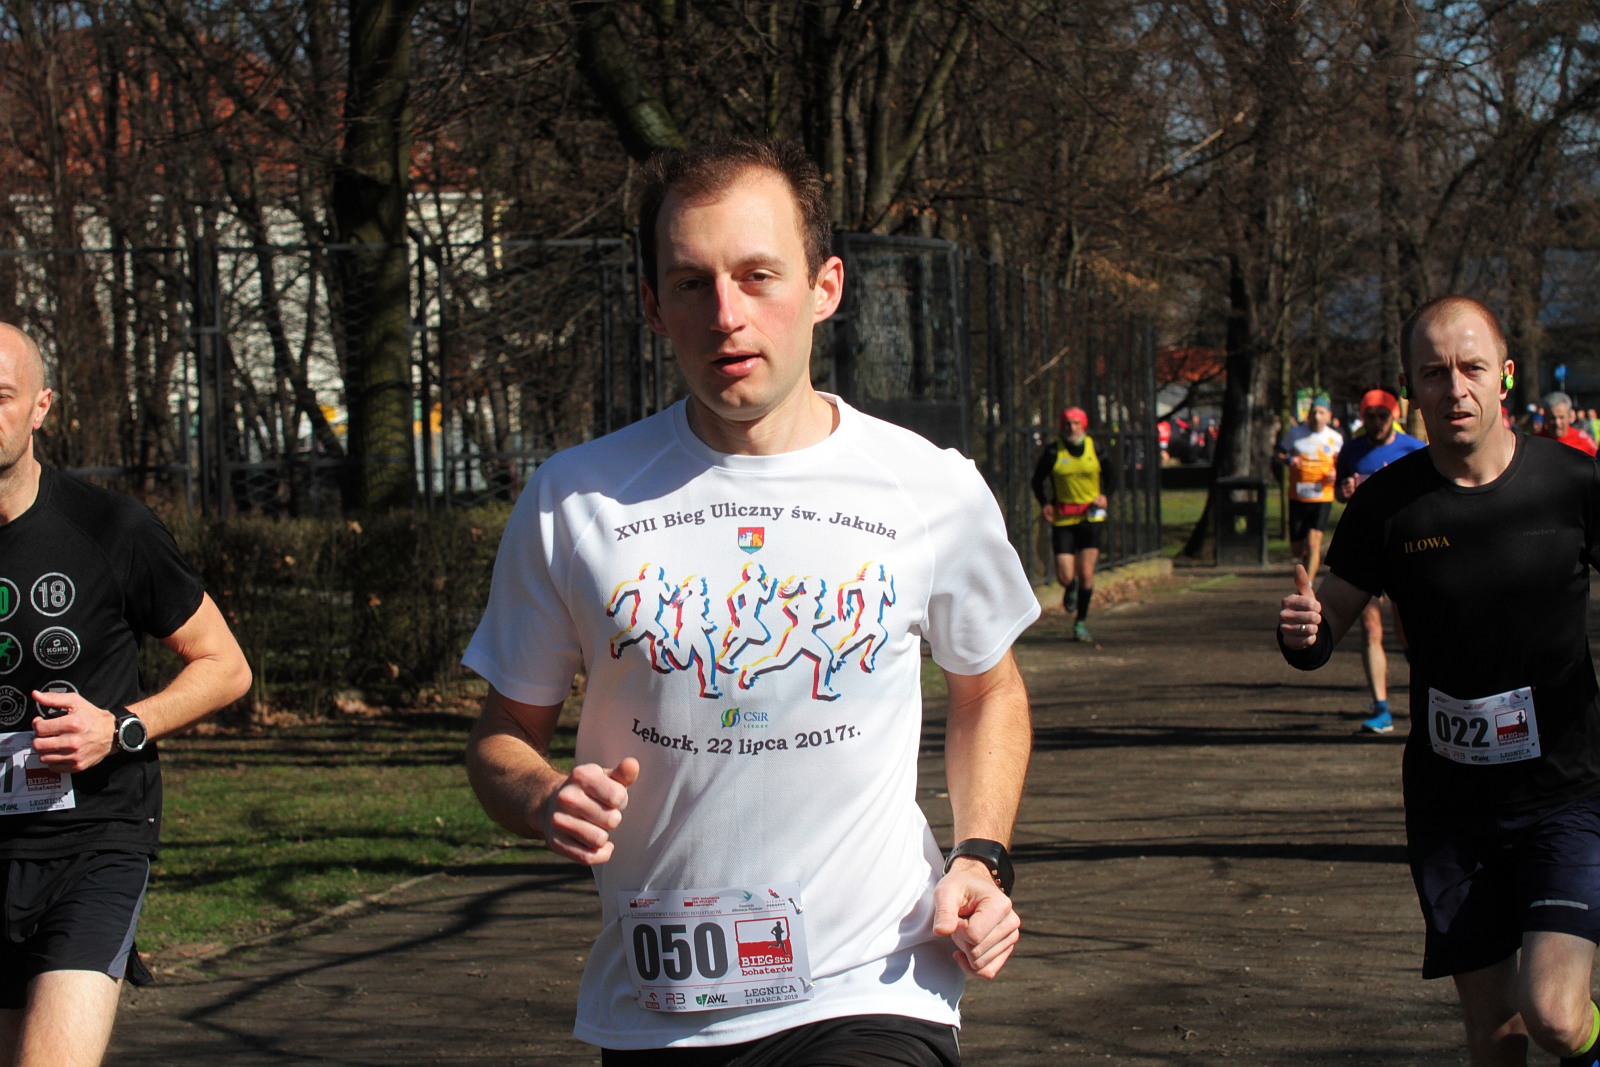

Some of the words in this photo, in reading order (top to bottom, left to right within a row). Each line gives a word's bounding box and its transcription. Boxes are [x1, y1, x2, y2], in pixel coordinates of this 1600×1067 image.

[614, 518, 658, 541] XVII
[664, 509, 705, 529] Bieg
[710, 502, 784, 520] Uliczny
[791, 505, 821, 521] św.
[828, 511, 897, 540] Jakuba
[38, 580, 66, 608] 18
[743, 711, 768, 721] CSiR
[1435, 711, 1490, 747] 022
[632, 718, 699, 755] Lębork,
[707, 738, 733, 755] 22
[739, 738, 788, 756] lipca
[795, 724, 861, 749] 2017r.
[28, 777, 49, 785] BIEG
[633, 922, 728, 981] 050
[741, 954, 774, 967] BIEG
[774, 954, 791, 964] stu
[741, 965, 793, 976] bohaterów
[744, 985, 796, 997] LEGNICA
[755, 996, 781, 1004] MARCA
